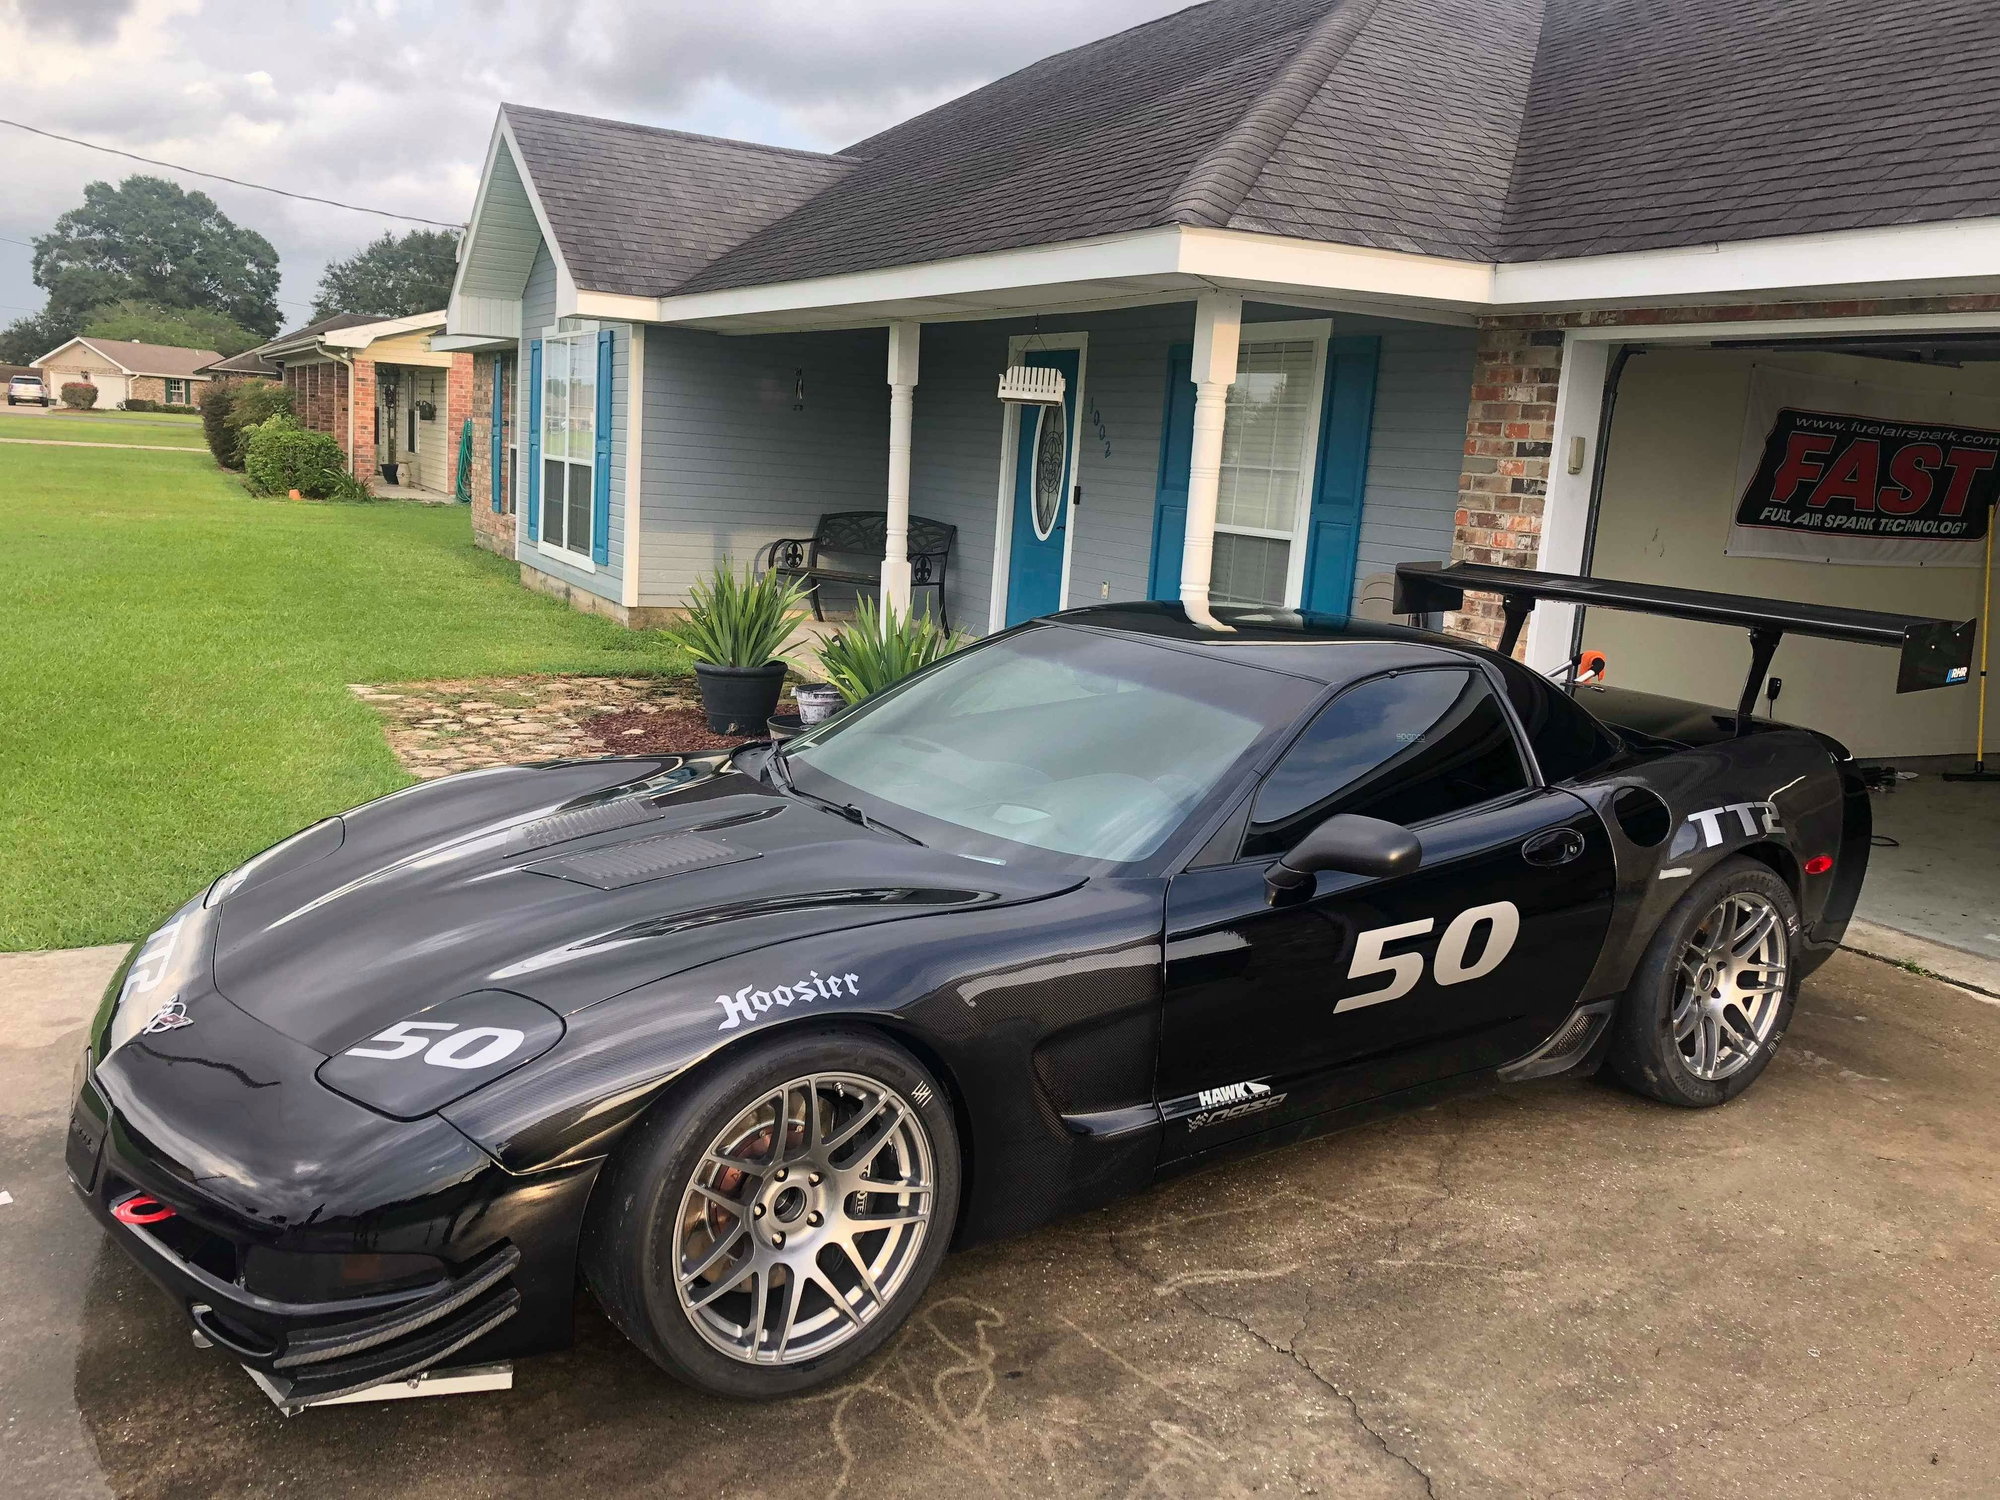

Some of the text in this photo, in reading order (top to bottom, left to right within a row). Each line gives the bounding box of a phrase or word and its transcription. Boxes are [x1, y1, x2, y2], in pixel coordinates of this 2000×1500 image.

[1089, 396, 1111, 458] 1002
[1769, 431, 1998, 517] FAST
[1759, 507, 1968, 535] FUEL AIR SPARK TECHNOLOGY
[1687, 801, 1787, 848] TT2
[1333, 900, 1520, 1014] 50
[714, 970, 860, 1031] Hoosier
[344, 1021, 525, 1069] 50
[1198, 1082, 1249, 1107] HAWK
